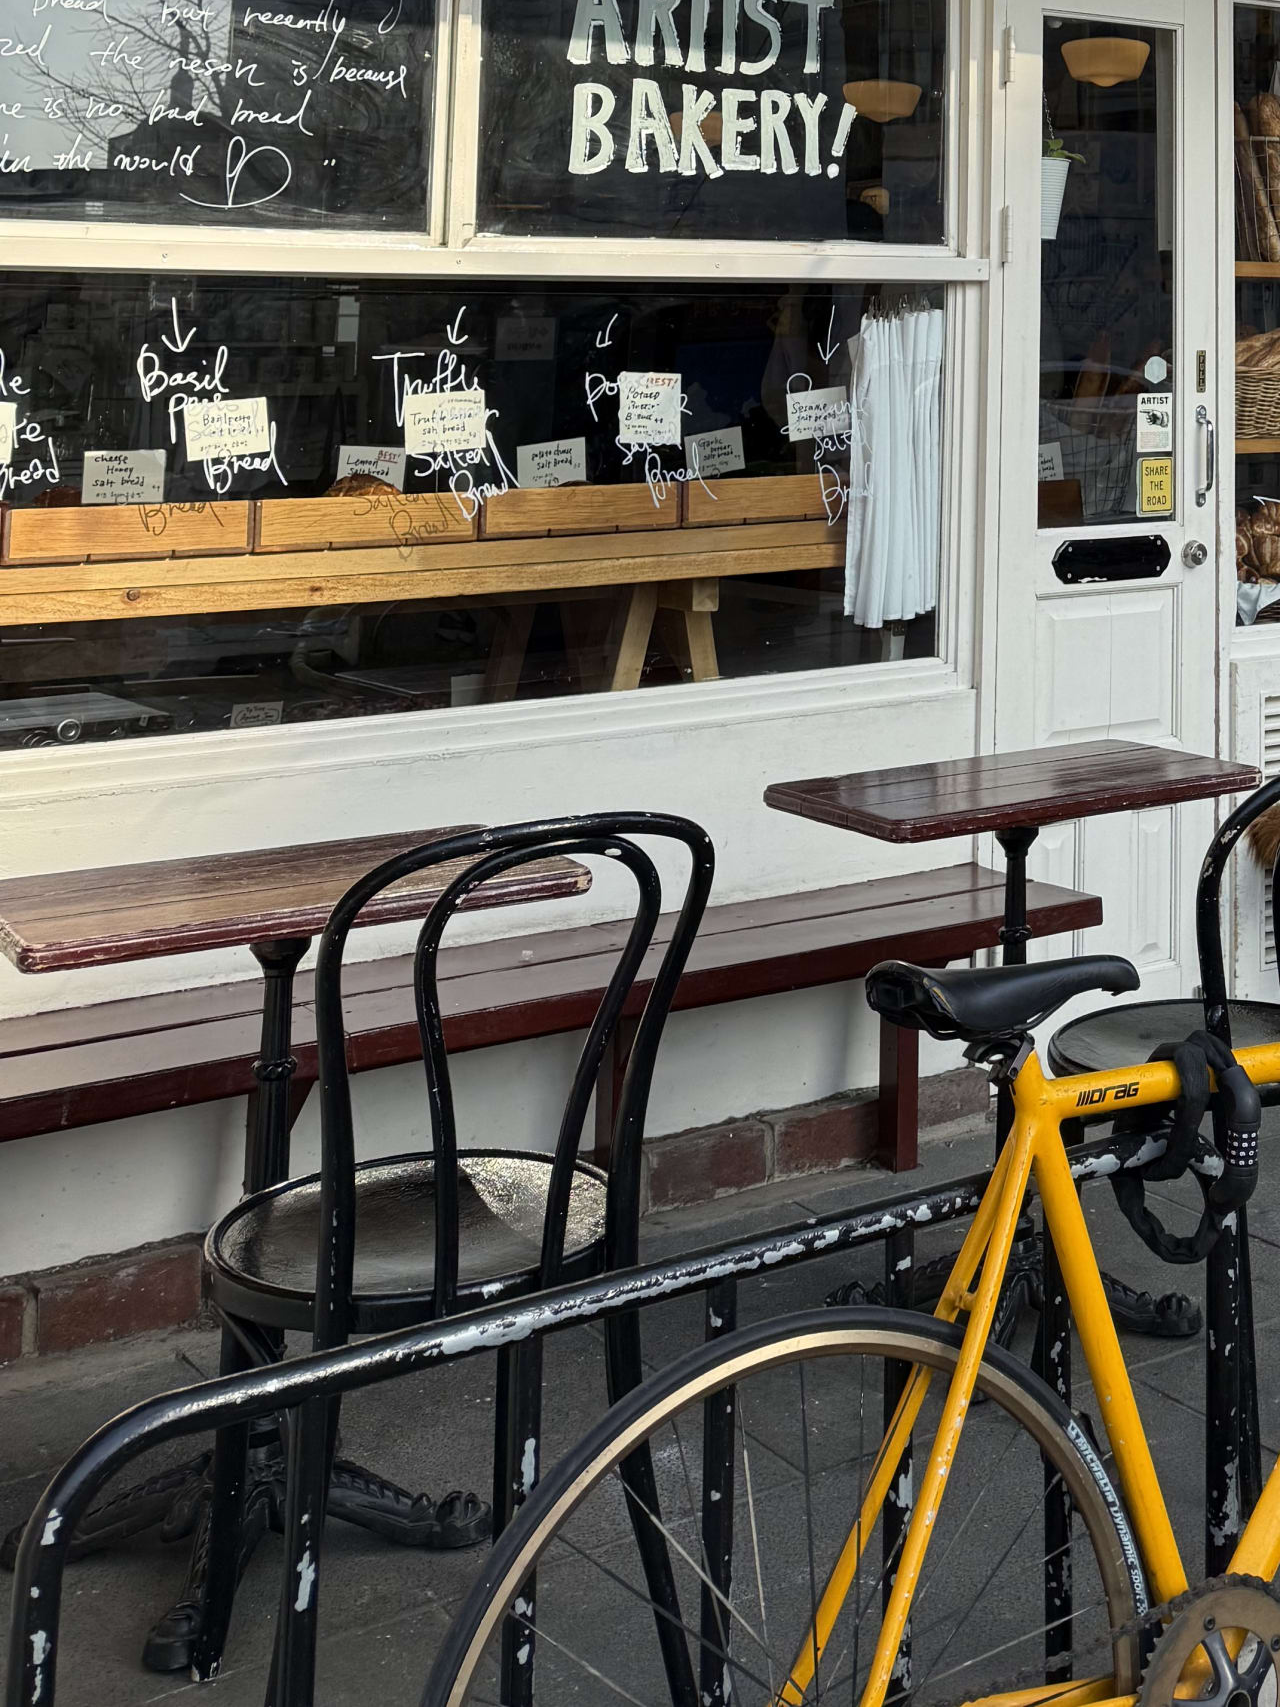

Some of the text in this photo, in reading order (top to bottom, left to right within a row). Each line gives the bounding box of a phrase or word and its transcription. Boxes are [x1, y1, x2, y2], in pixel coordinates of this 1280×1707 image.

[91, 38, 145, 72] the
[330, 59, 408, 98] because
[43, 97, 65, 121] is
[85, 97, 123, 121] no
[230, 90, 314, 136] bread
[568, 77, 858, 180] BAKERY!
[53, 134, 92, 170] the
[136, 343, 230, 403] Basil
[1140, 396, 1169, 405] ARTIST
[106, 465, 134, 479] Honey
[346, 453, 379, 469] Lemon
[1144, 465, 1169, 476] SHARE
[1149, 480, 1164, 491] THE
[1146, 495, 1167, 506] ROAD
[1077, 1435, 1119, 1508] MICHELIN
